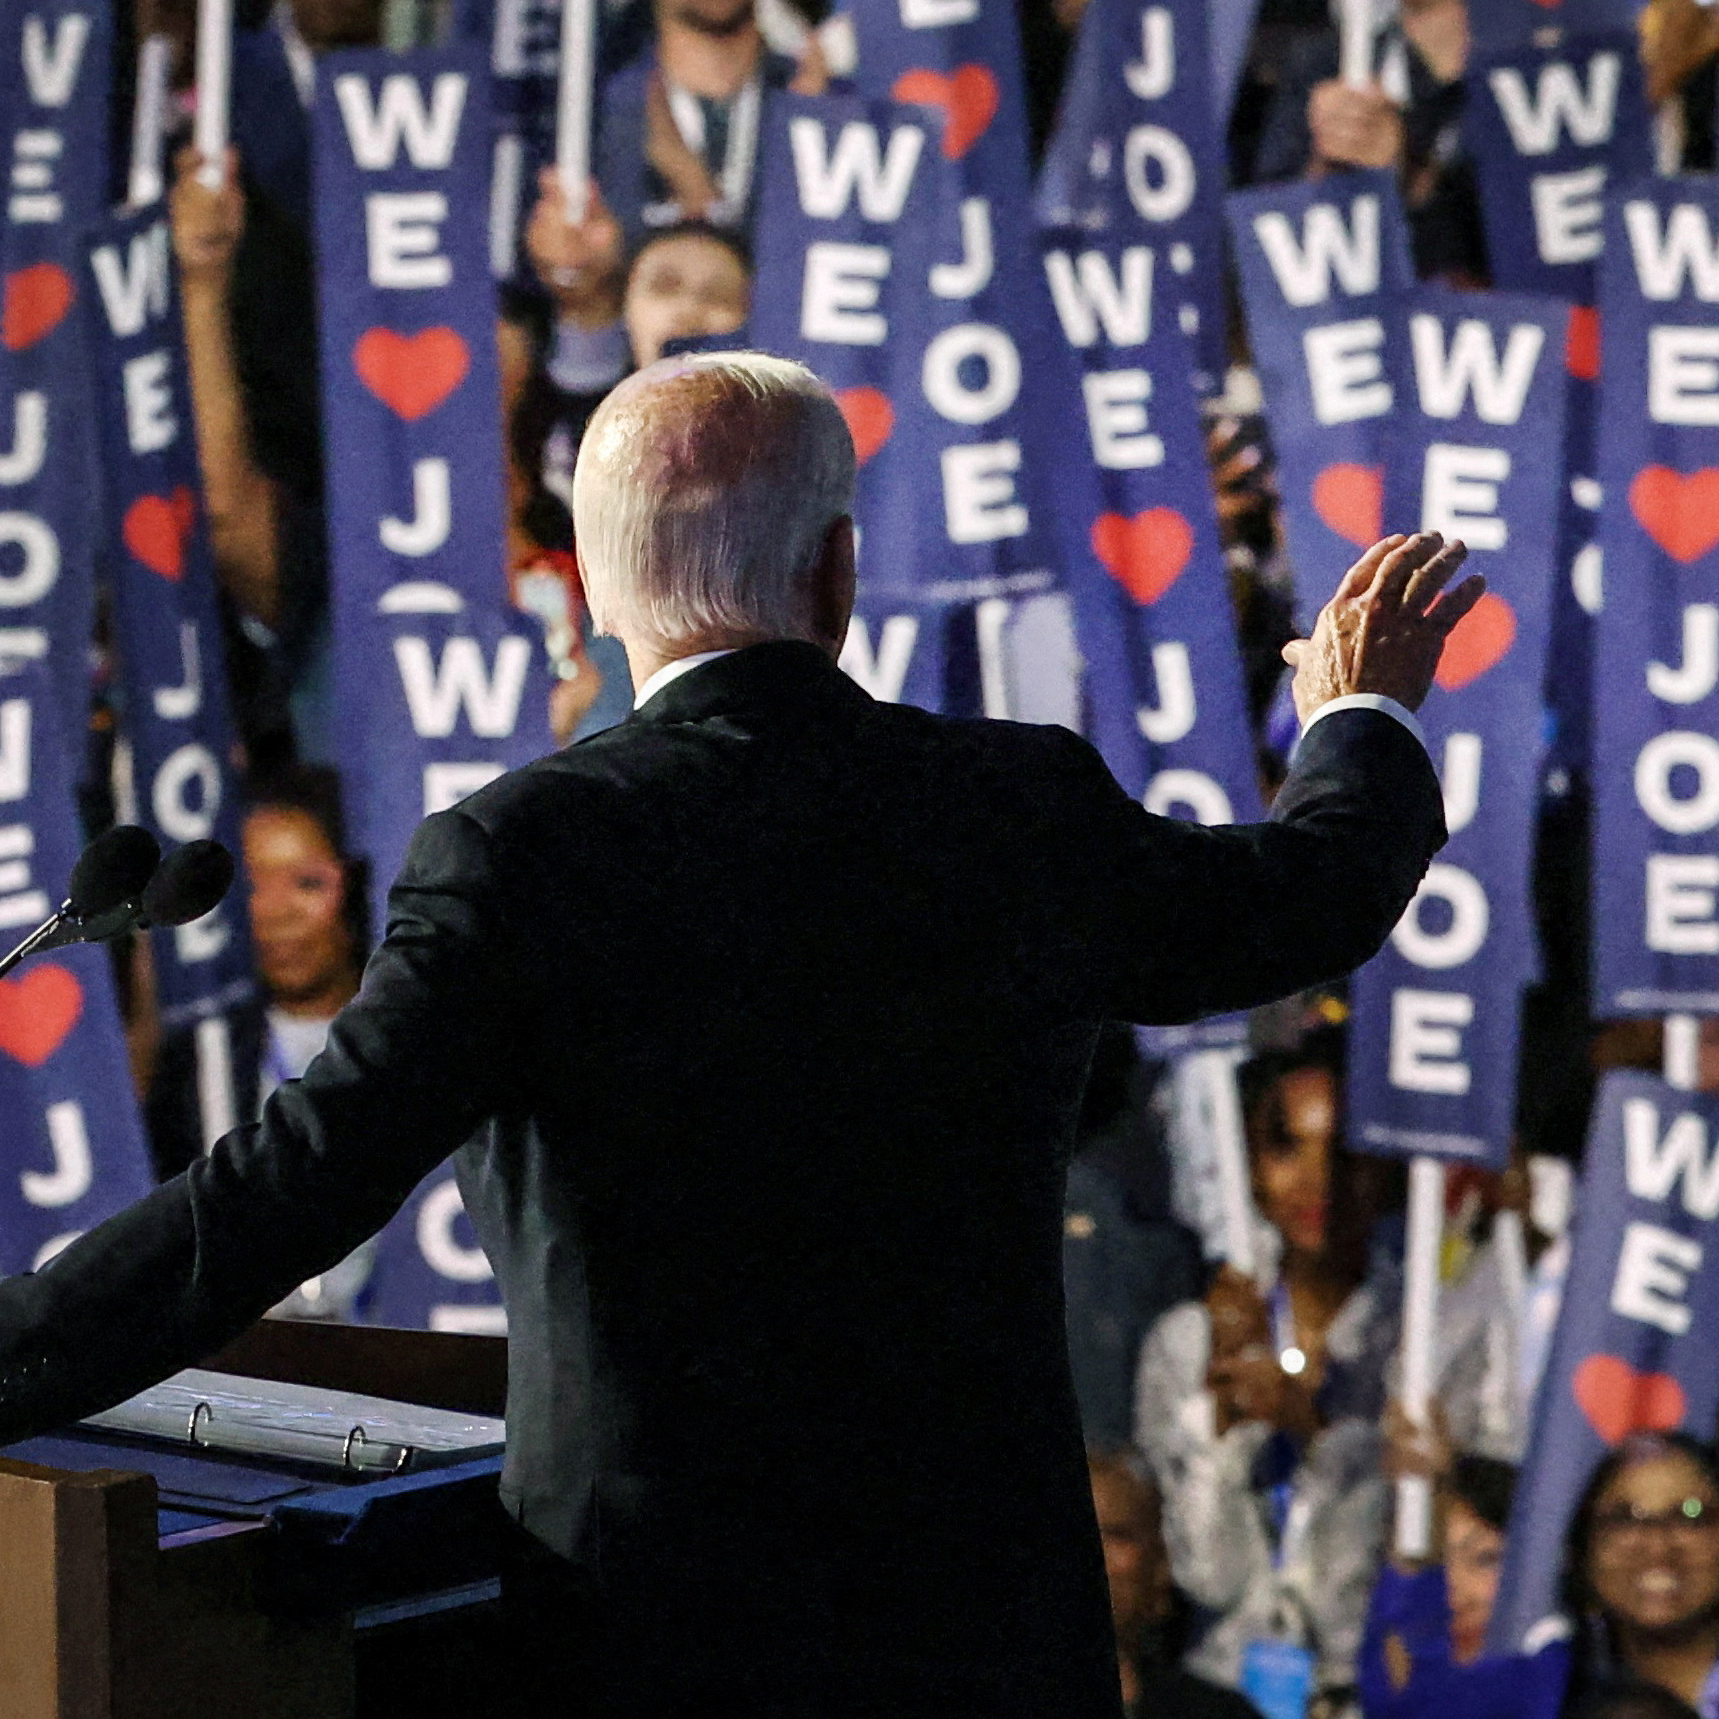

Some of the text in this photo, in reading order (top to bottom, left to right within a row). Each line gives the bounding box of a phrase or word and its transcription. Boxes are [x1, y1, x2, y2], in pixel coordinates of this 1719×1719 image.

[336, 74, 466, 289] WE
[789, 117, 925, 345] WE
[1493, 56, 1617, 262] WE
[919, 199, 1028, 545] JOE
[1046, 247, 1164, 469] WE
[1253, 197, 1393, 428] WE
[1391, 313, 1545, 1094] WE JOE
